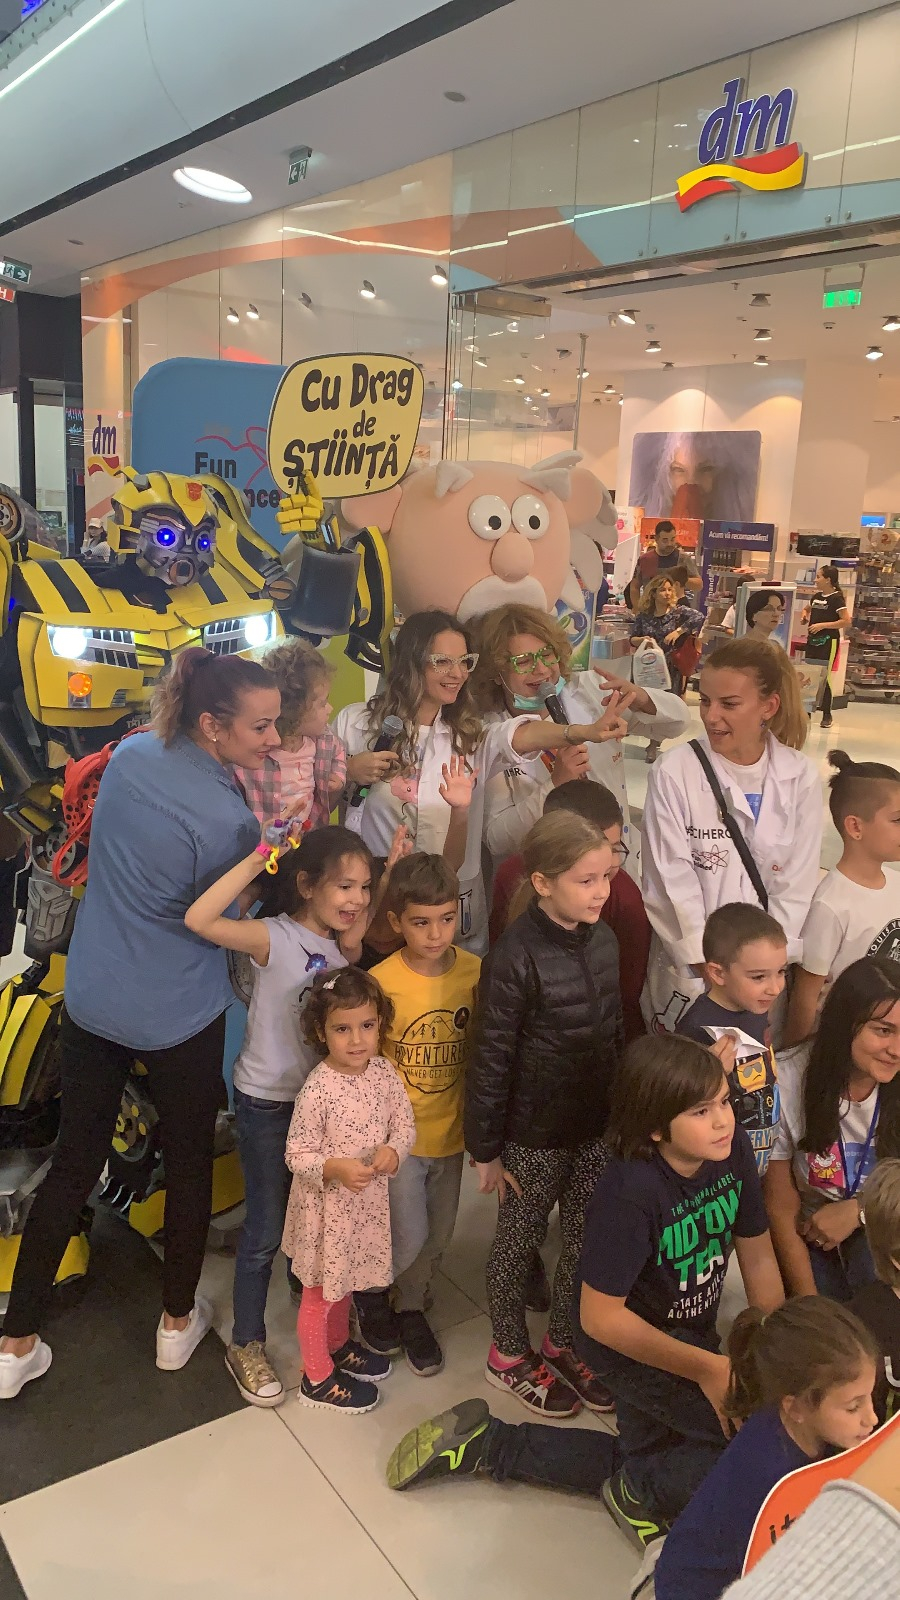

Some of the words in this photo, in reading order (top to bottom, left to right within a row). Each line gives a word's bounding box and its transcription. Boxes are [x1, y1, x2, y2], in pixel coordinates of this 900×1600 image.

[698, 77, 795, 165] dm
[301, 368, 342, 413] Cu
[350, 362, 415, 407] Drag
[92, 414, 117, 455] dm
[352, 409, 377, 438] de
[194, 451, 237, 479] Fun
[708, 530, 724, 539] Acum
[429, 1069, 443, 1079] GET
[670, 1202, 685, 1217] THE
[672, 1292, 703, 1310] STATE
